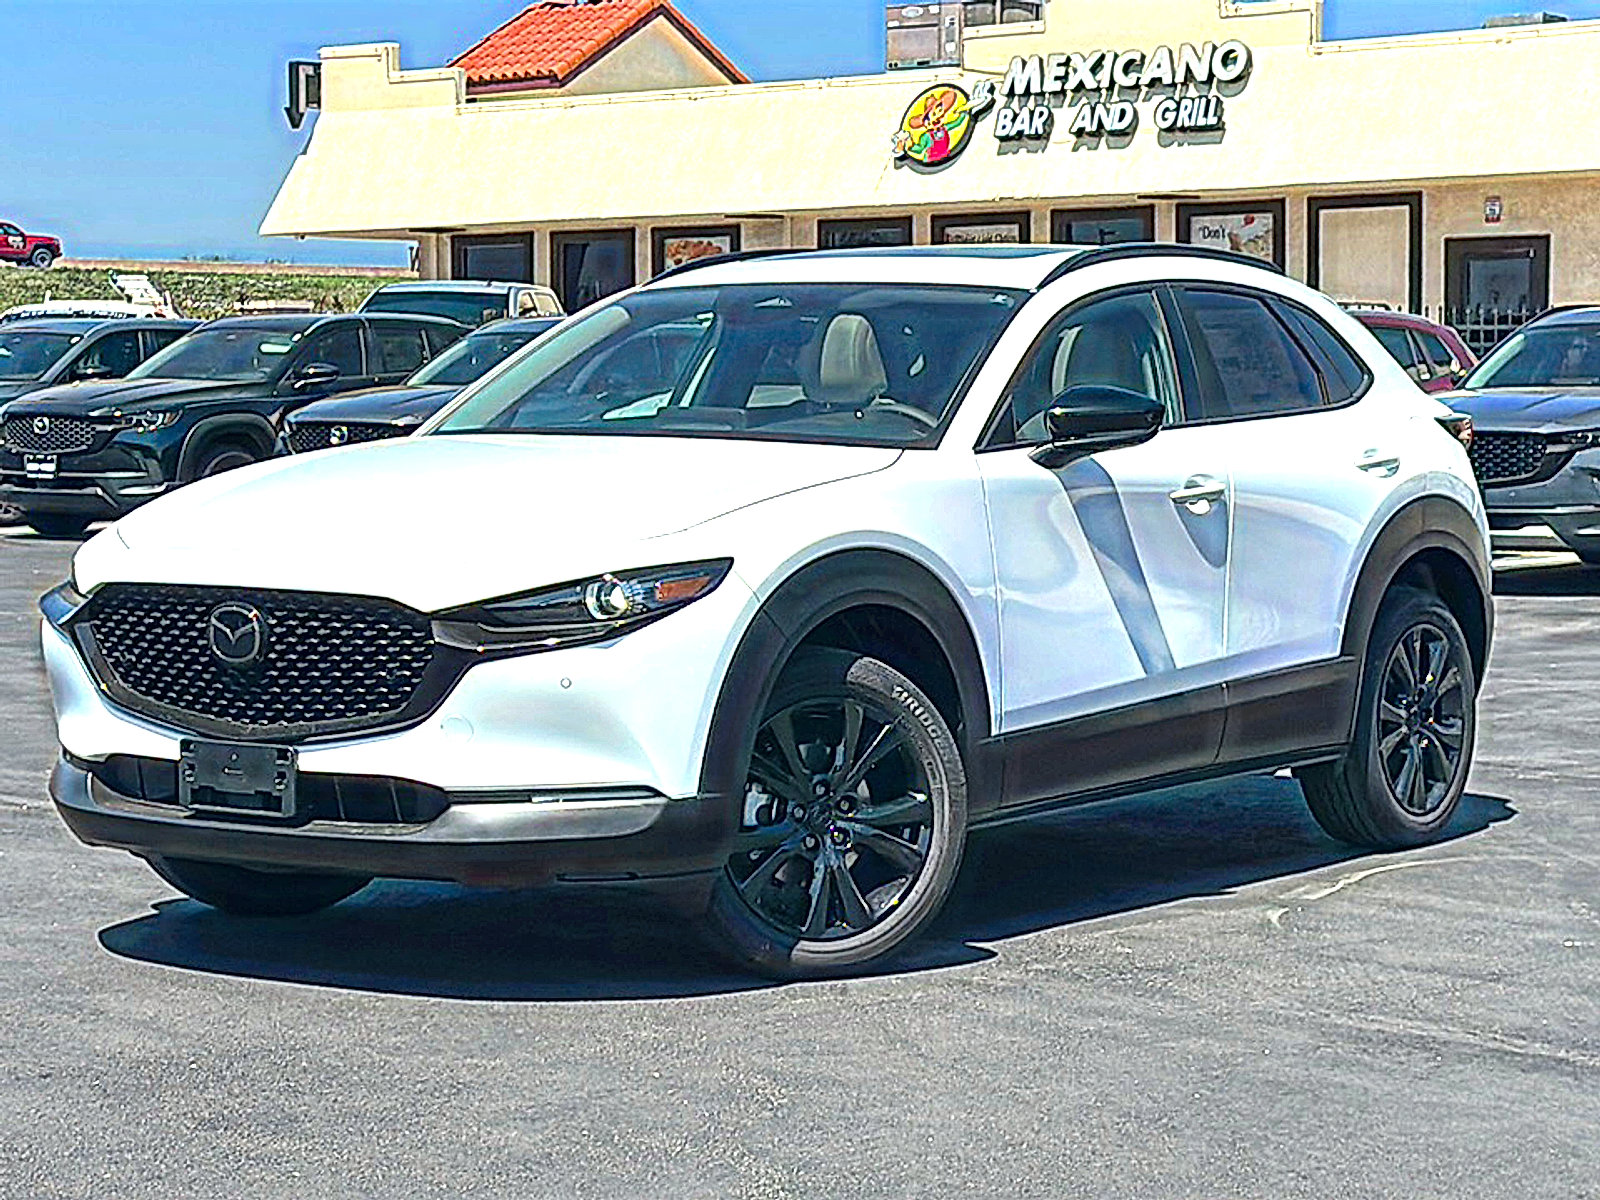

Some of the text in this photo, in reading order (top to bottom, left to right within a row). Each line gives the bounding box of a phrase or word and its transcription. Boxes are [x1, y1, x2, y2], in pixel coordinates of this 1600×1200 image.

[1003, 40, 1252, 95] MEXICANO
[995, 96, 1223, 139] BAR AND GRILL
